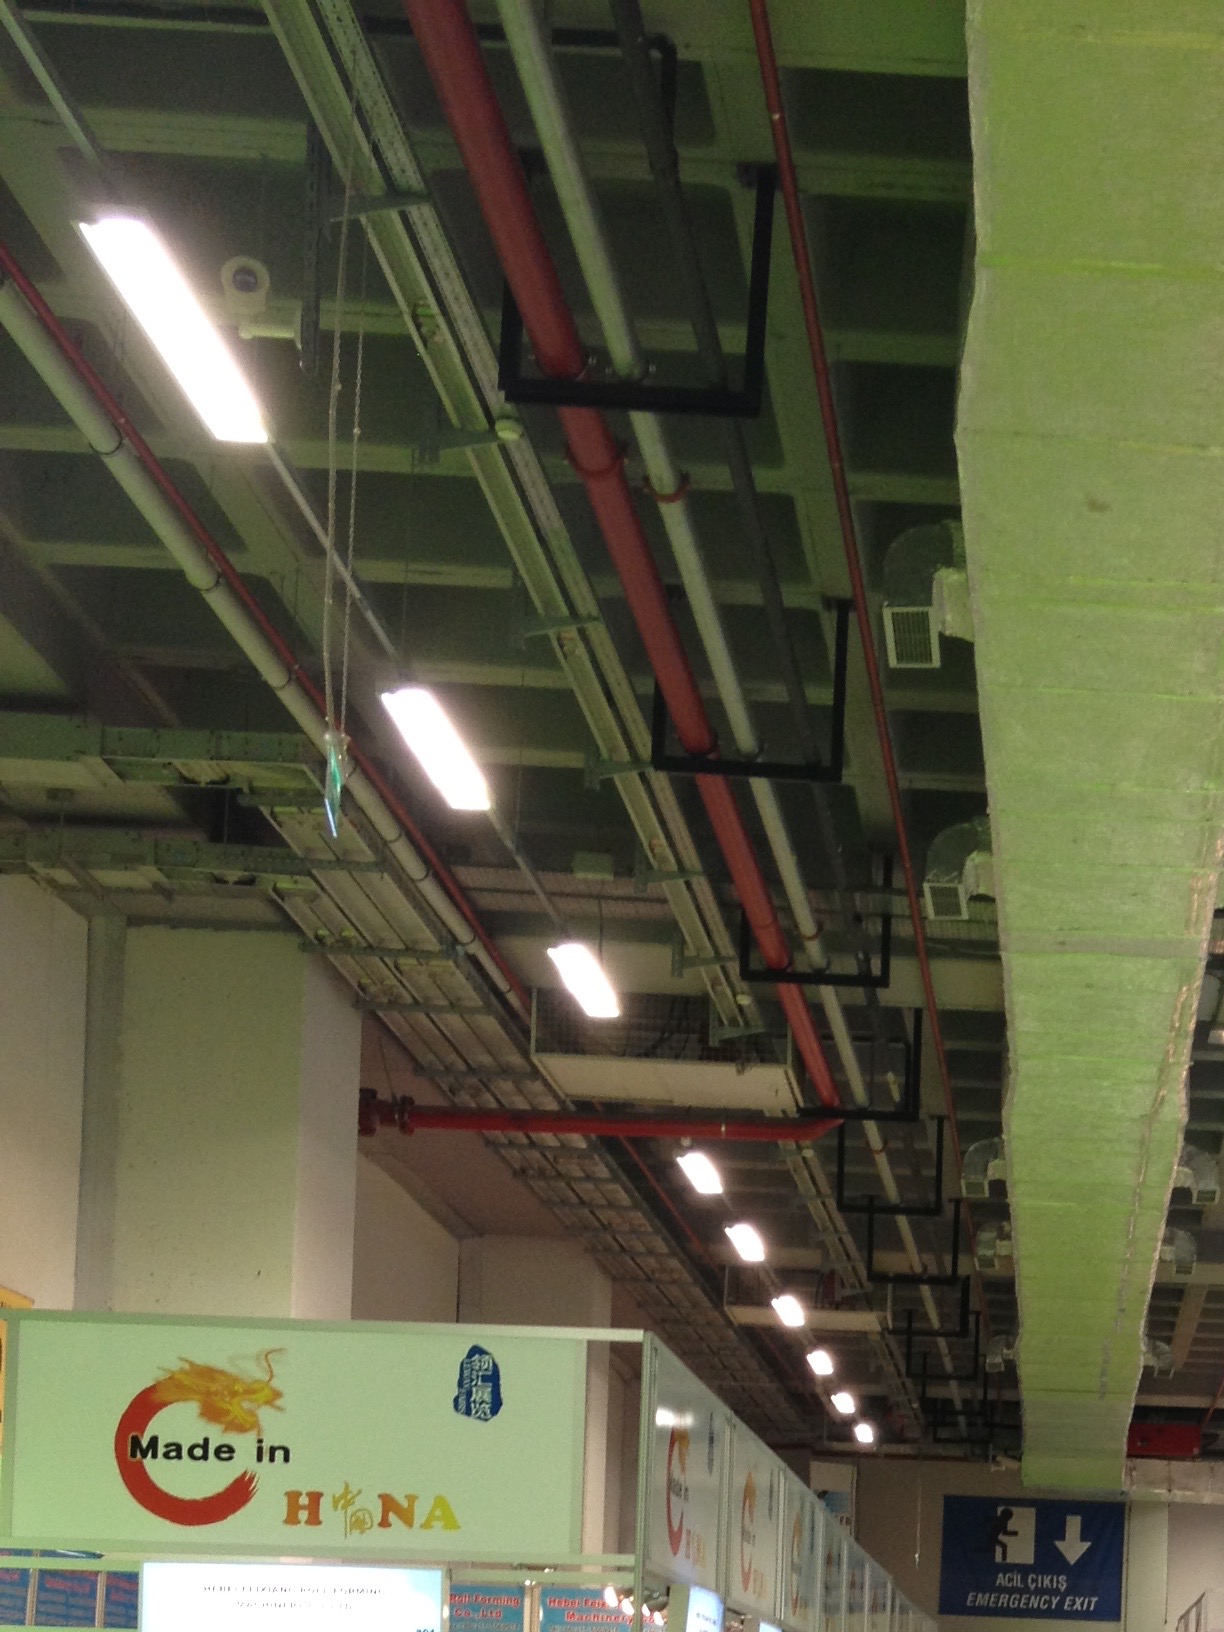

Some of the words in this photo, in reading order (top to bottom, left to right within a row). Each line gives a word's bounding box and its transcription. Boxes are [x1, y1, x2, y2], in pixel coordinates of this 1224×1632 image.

[128, 1434, 236, 1462] Made
[255, 1438, 291, 1464] in
[1027, 1573, 1068, 1592] ÇIKIŞ
[966, 1592, 1060, 1610] EMERGENCY
[1064, 1596, 1099, 1611] EXIT
